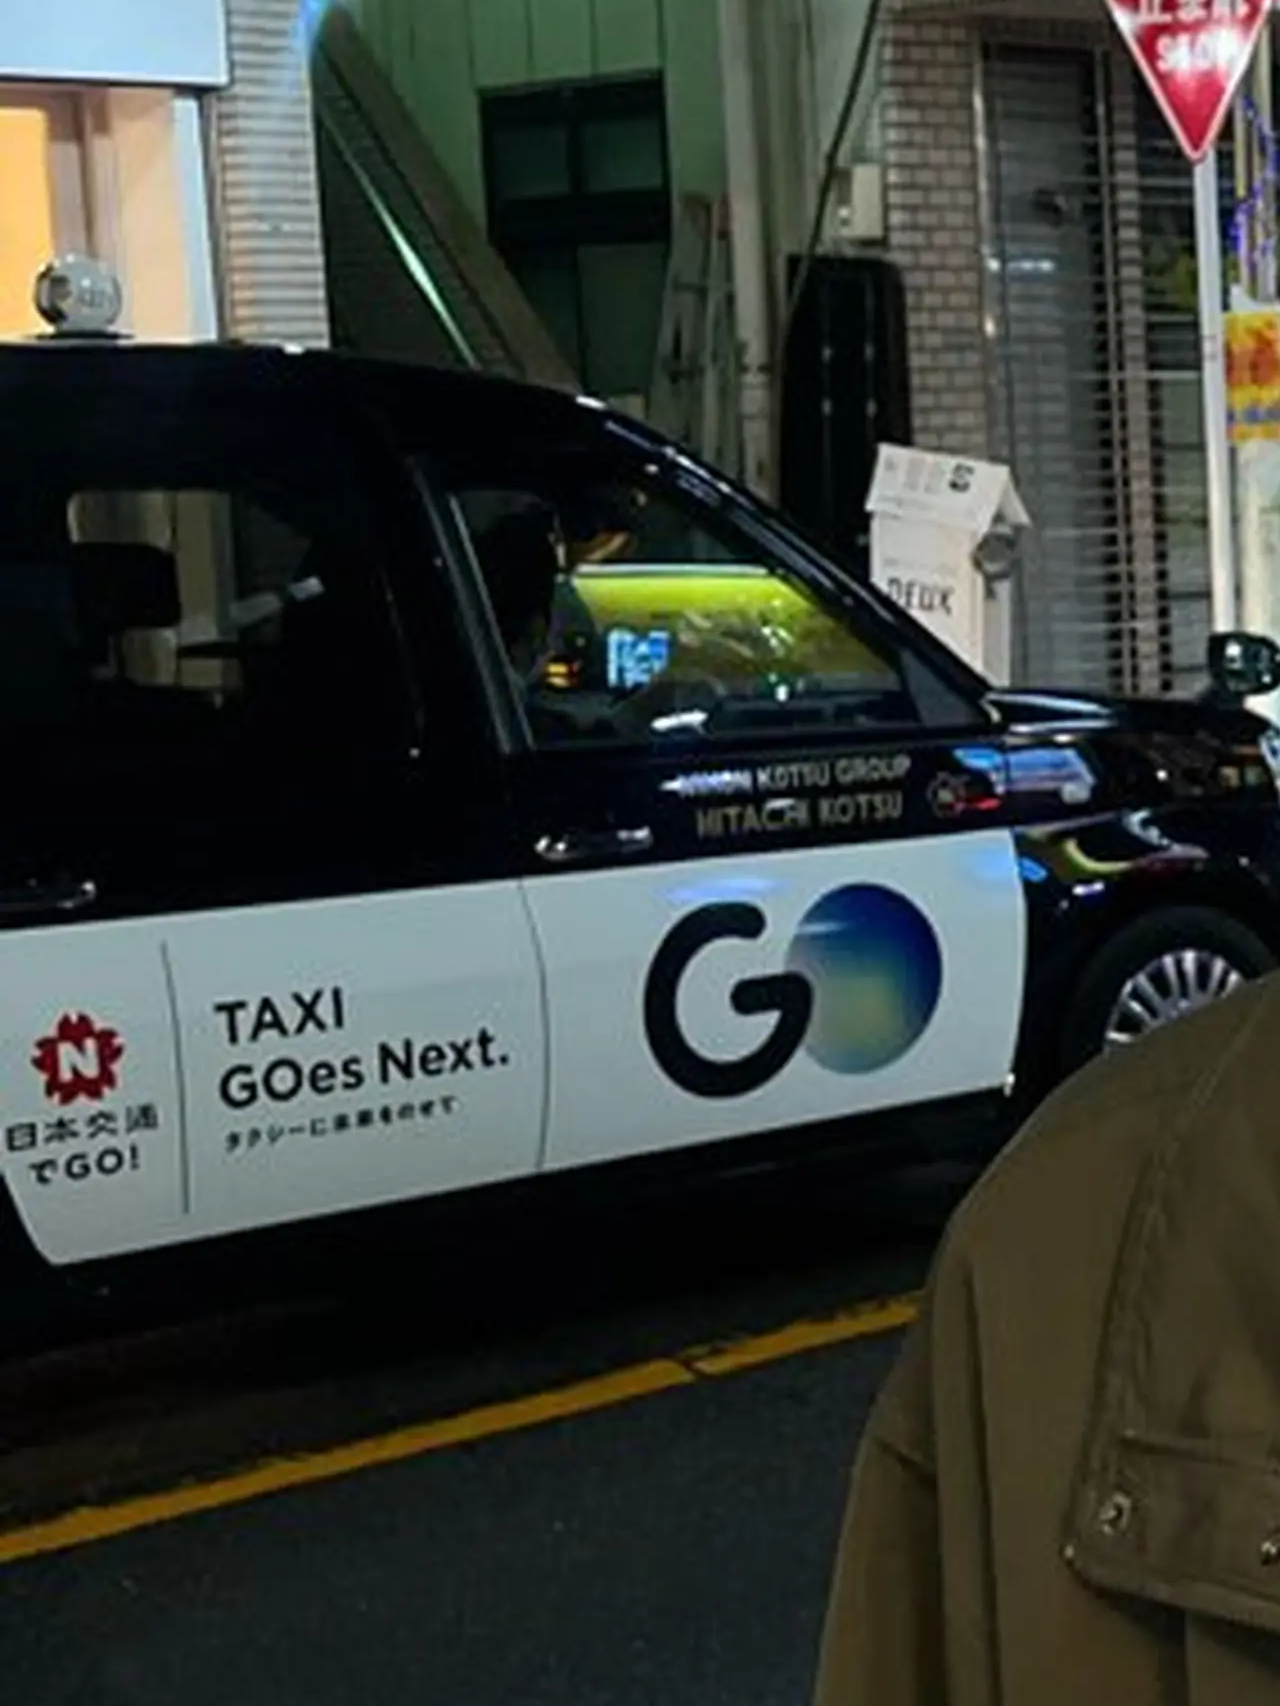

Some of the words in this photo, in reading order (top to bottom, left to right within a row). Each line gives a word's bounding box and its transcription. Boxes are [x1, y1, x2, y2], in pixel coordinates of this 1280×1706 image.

[757, 760, 831, 791] KOTSU
[834, 754, 911, 784] GROUP
[695, 798, 809, 837] HITACHI
[819, 791, 902, 825] KOTSU
[644, 881, 943, 1099] GO
[214, 986, 345, 1045] TAXI
[219, 1057, 365, 1110] GOes
[378, 1027, 510, 1084] Next.
[6, 1103, 159, 1153] 日本交通
[30, 1144, 140, 1186] でGO!
